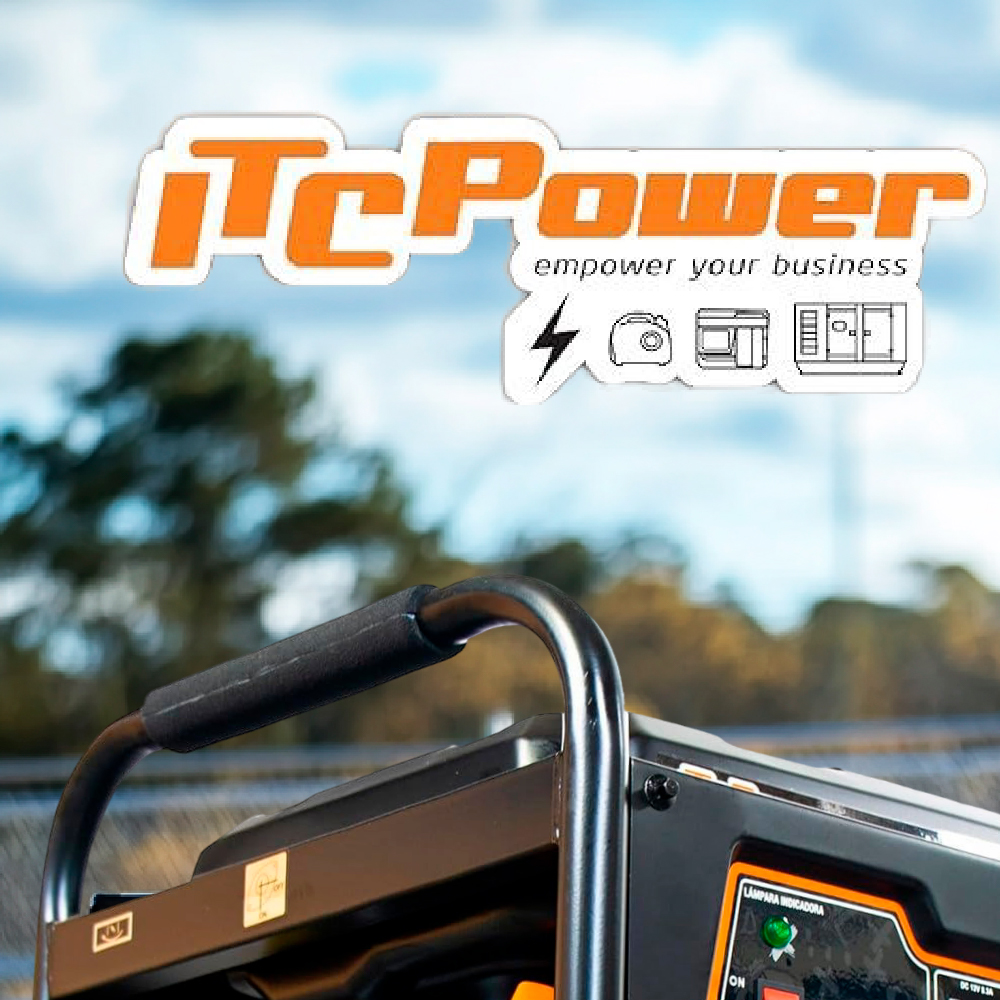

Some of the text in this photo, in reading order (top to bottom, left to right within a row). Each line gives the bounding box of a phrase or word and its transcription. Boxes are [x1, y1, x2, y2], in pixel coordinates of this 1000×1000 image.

[780, 895, 825, 917] INDICADORA
[728, 974, 746, 989] ON
[960, 980, 970, 992] DC
